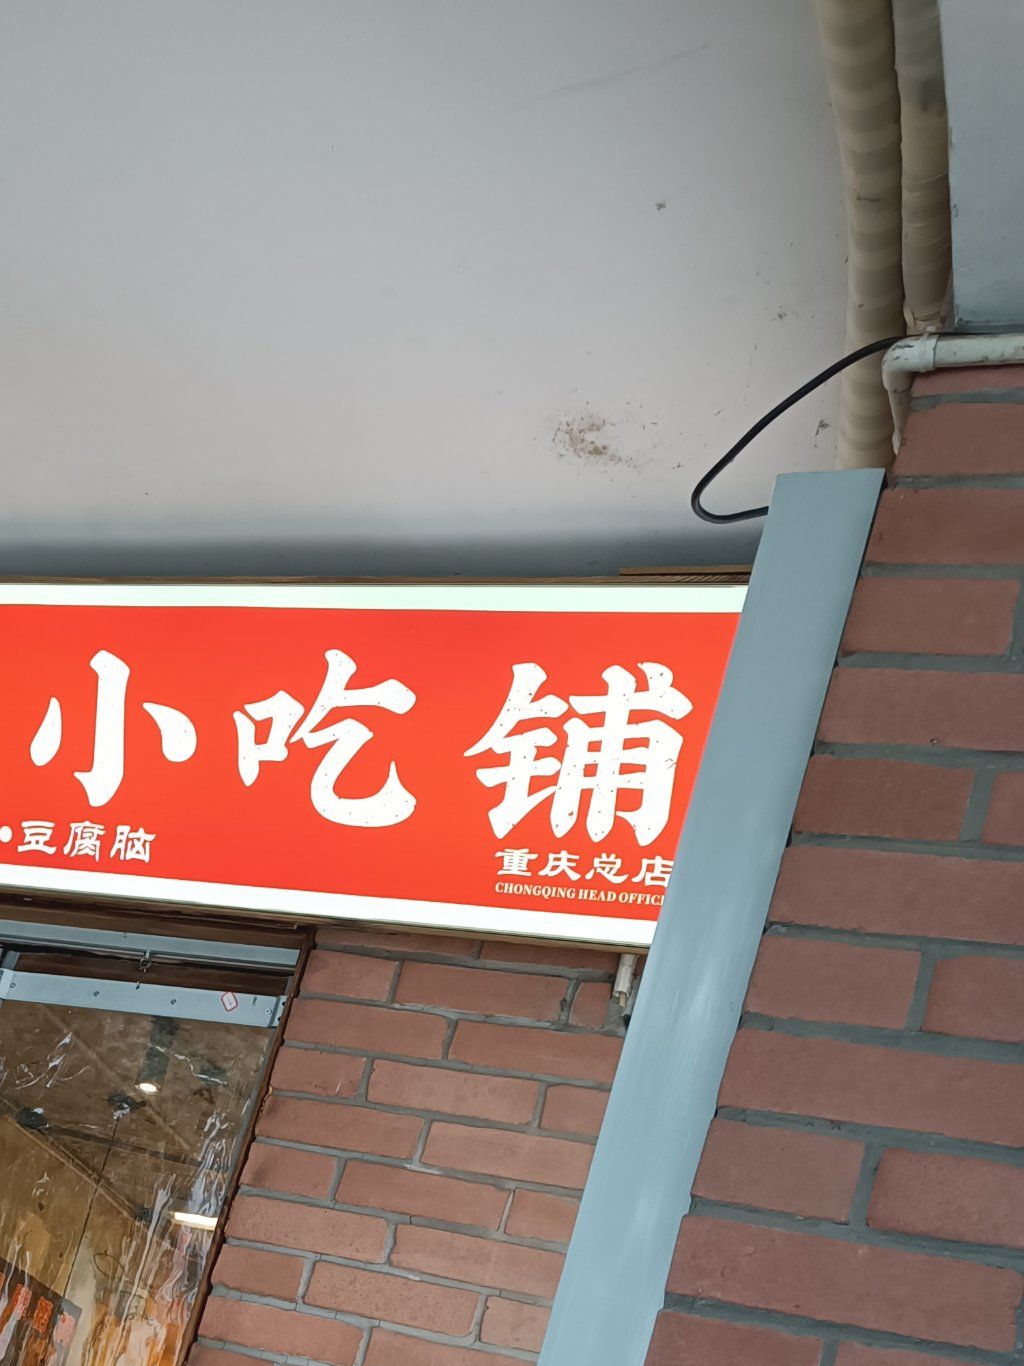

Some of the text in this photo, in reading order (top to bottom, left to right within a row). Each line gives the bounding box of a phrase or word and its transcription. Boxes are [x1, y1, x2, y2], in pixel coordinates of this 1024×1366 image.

[16, 820, 157, 864] 豆腐脑
[494, 848, 675, 888] 重庆总店
[495, 882, 576, 900] CHONGQING
[578, 889, 617, 903] HEAD
